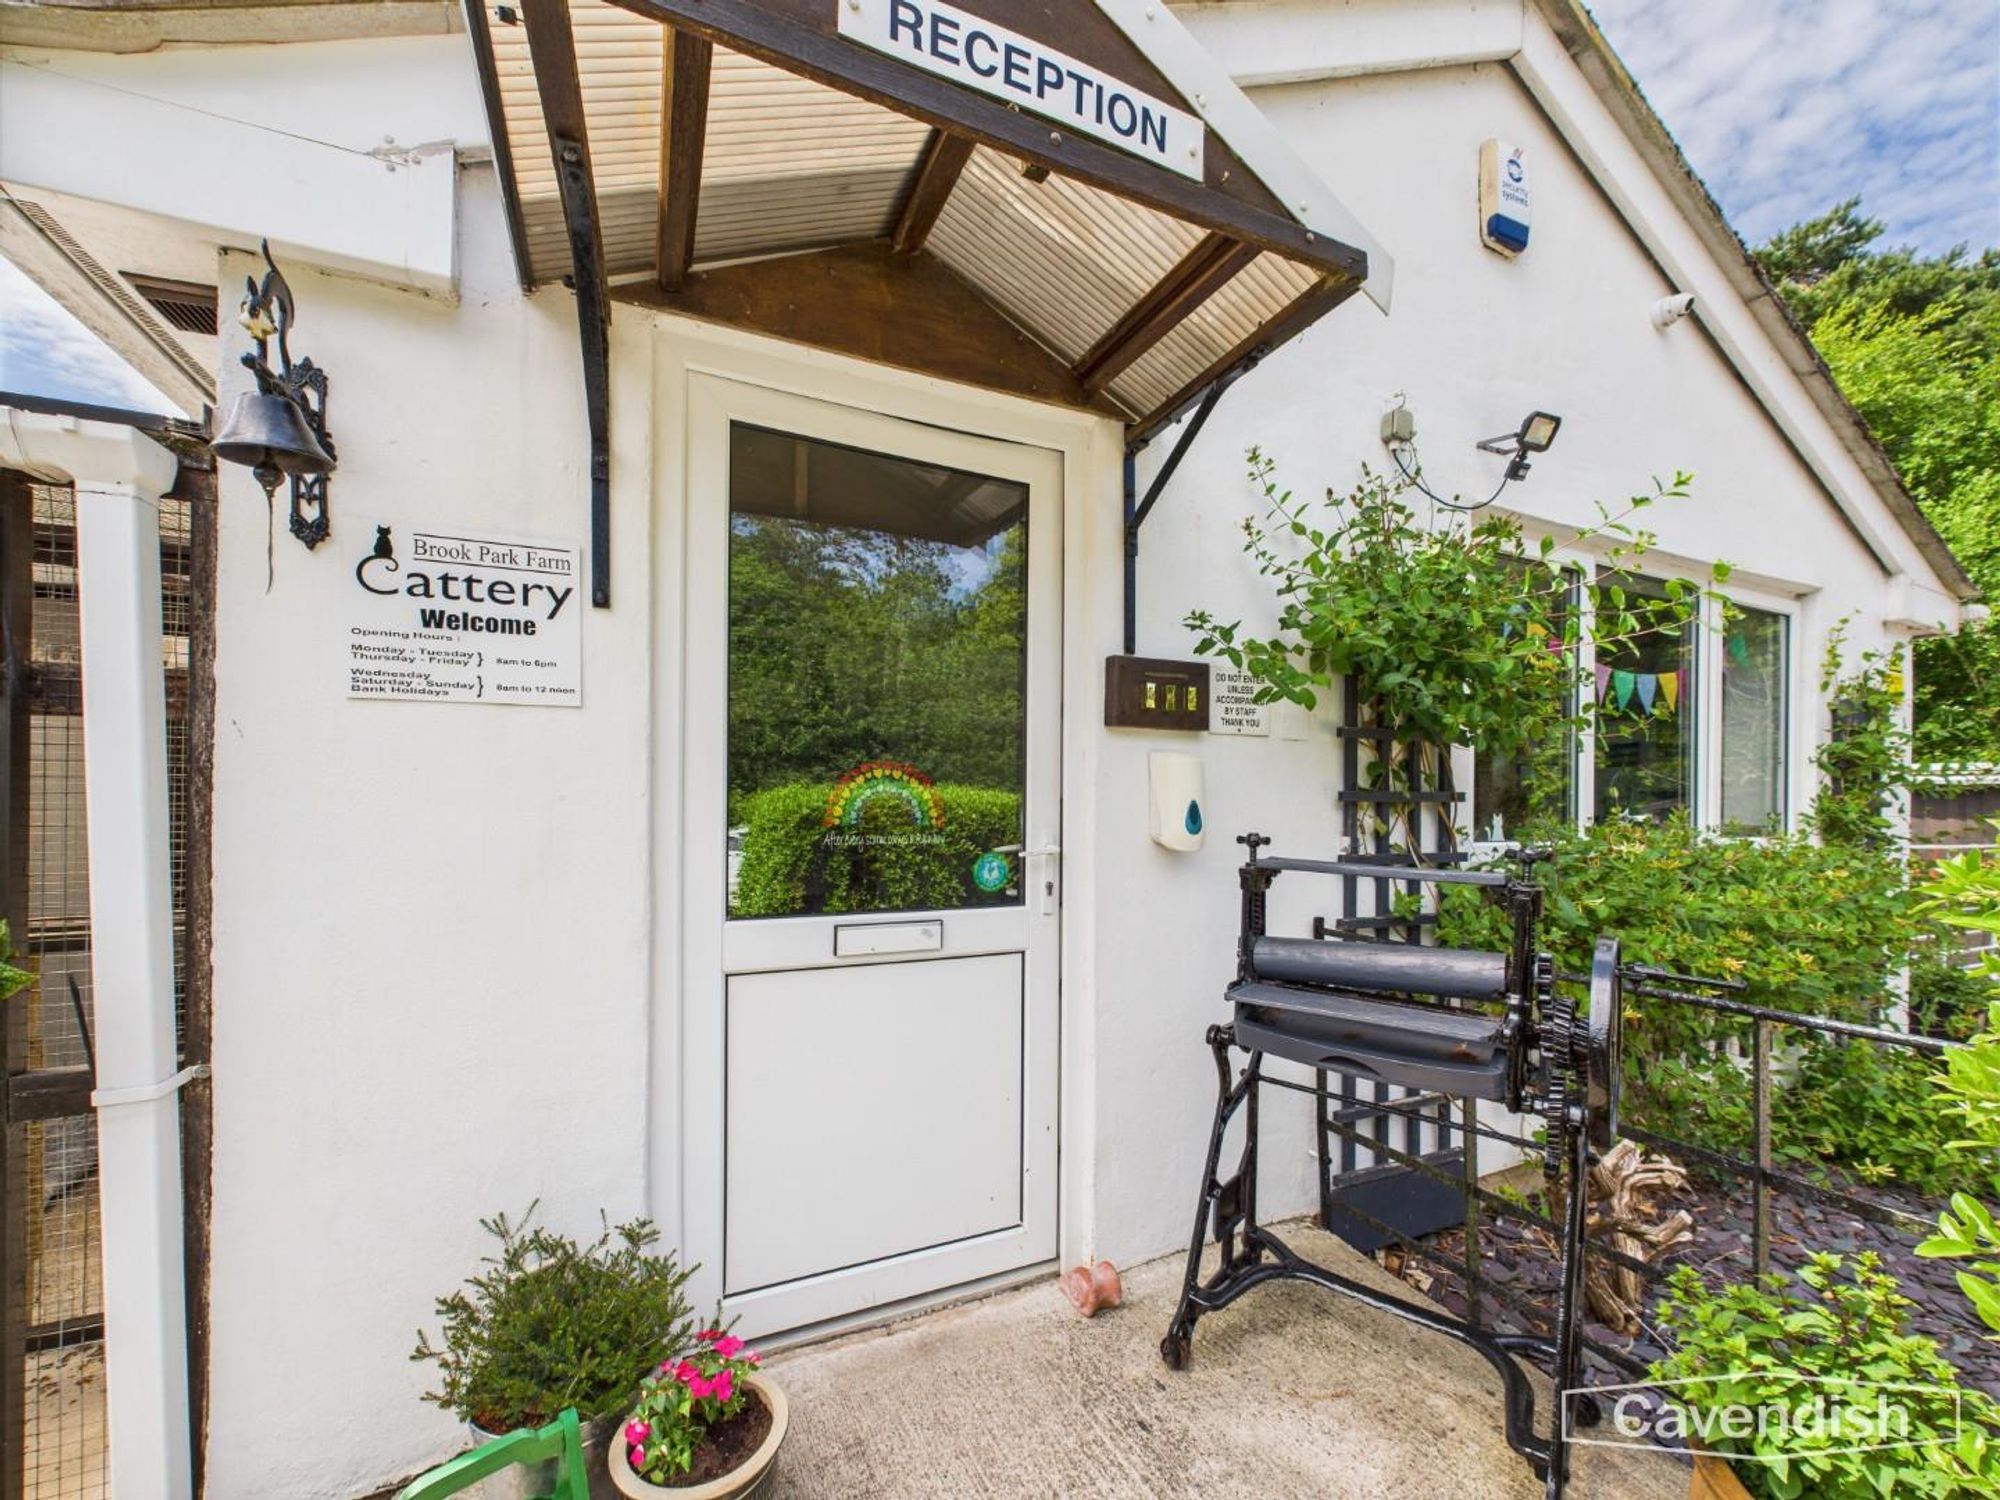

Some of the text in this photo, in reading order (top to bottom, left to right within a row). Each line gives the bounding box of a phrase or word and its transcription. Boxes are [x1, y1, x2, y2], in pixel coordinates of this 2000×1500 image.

[889, 0, 1167, 154] RECEPTION
[413, 538, 571, 571] Brook Park Farm
[356, 555, 574, 620] Cattery
[420, 608, 536, 636] Welcome
[351, 627, 410, 639] Opening
[413, 632, 453, 641] Hours
[351, 644, 406, 655] Monday
[419, 648, 475, 659] Tuesday
[352, 652, 416, 663] Thursday
[429, 657, 470, 667] Friday
[521, 658, 532, 666] to
[351, 668, 431, 680] Wednesday
[1215, 673, 1226, 682] DO
[1227, 674, 1242, 683] NOT
[351, 676, 413, 687] Saturday
[426, 680, 475, 690] Sunday
[521, 685, 532, 693] to
[1227, 685, 1254, 694] UNLESS
[351, 684, 449, 696] Bank Holidays
[1224, 706, 1257, 716] BY STAFF
[1221, 717, 1260, 728] THANK YOU
